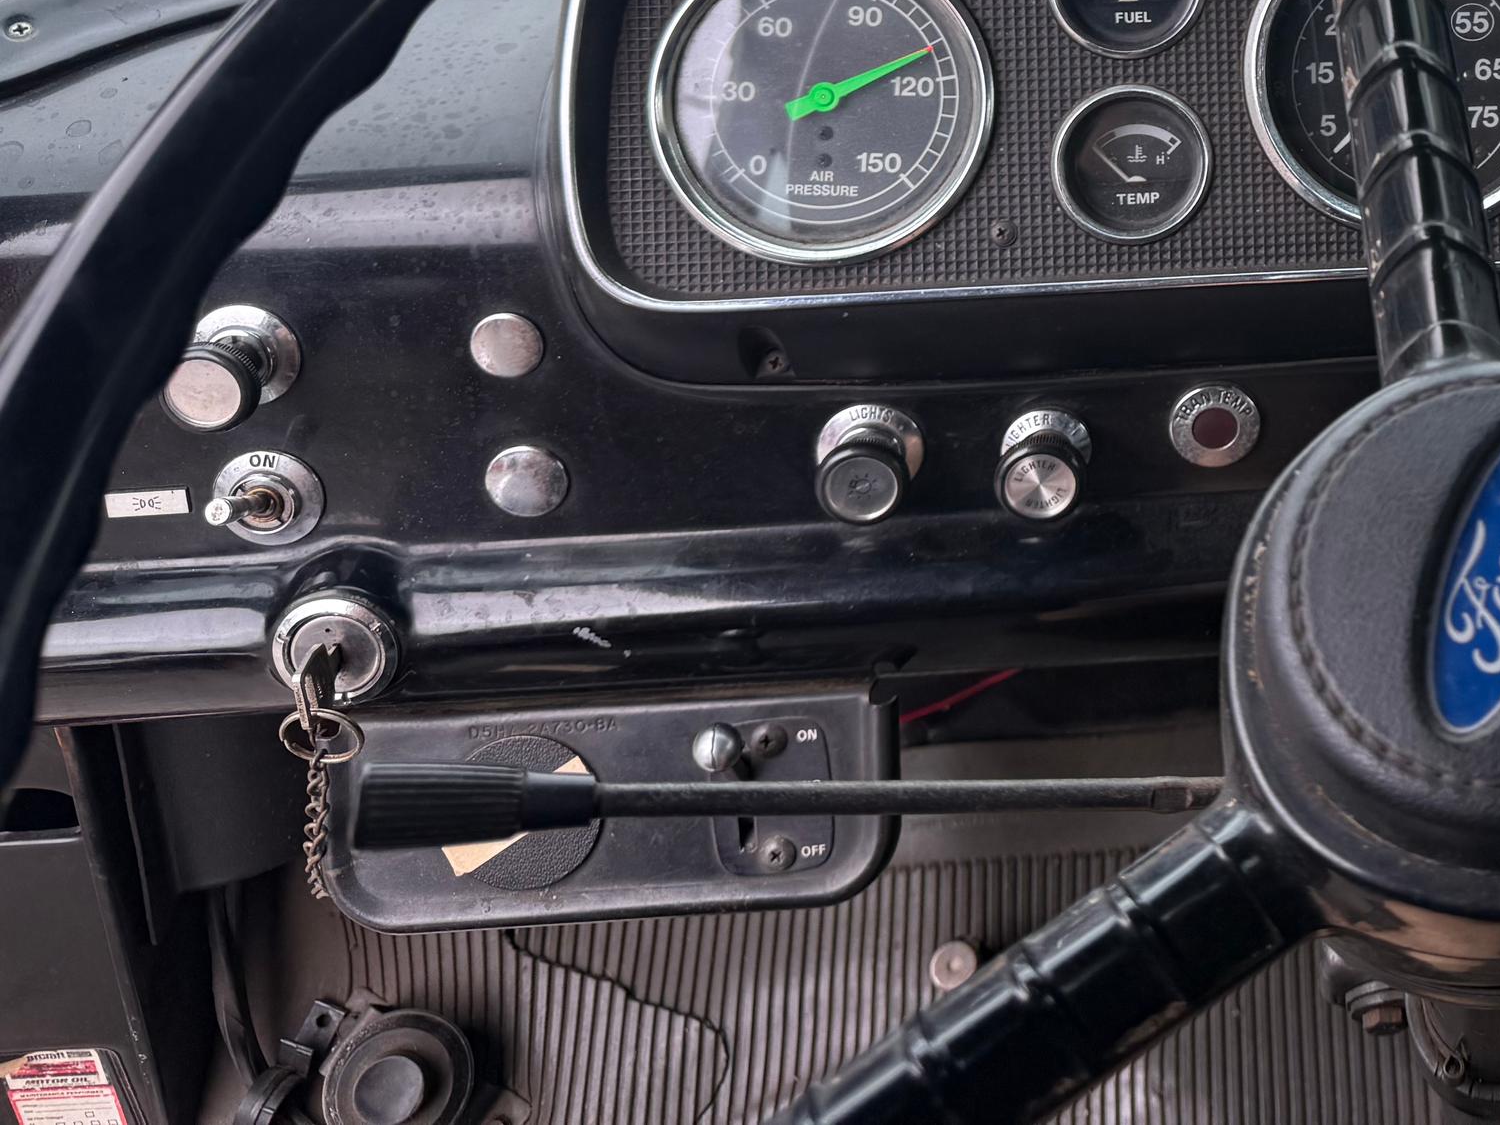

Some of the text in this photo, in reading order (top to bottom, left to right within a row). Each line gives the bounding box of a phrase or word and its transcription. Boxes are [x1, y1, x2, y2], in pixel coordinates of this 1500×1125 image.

[757, 16, 793, 38] 60
[848, 7, 883, 28] 90
[1115, 11, 1152, 24] FUEL
[1455, 11, 1490, 34] 55
[1305, 61, 1335, 84] 15
[721, 81, 756, 101] 30
[890, 76, 935, 97] 120
[1319, 114, 1337, 137] 5
[1467, 105, 1500, 128] 75
[750, 154, 768, 175] 0
[856, 151, 902, 174] 150
[1156, 155, 1165, 165] H
[809, 170, 834, 182] AIR
[785, 183, 859, 198] PRESSURE
[1116, 191, 1160, 205] TEMP
[1219, 389, 1254, 416] TEMP
[848, 406, 895, 423] LIGHTS
[1006, 413, 1051, 448] LIGHTER
[249, 453, 277, 470] ON
[1013, 460, 1056, 482] LIGHTER
[796, 728, 818, 742] ON
[801, 844, 826, 858] OFF
